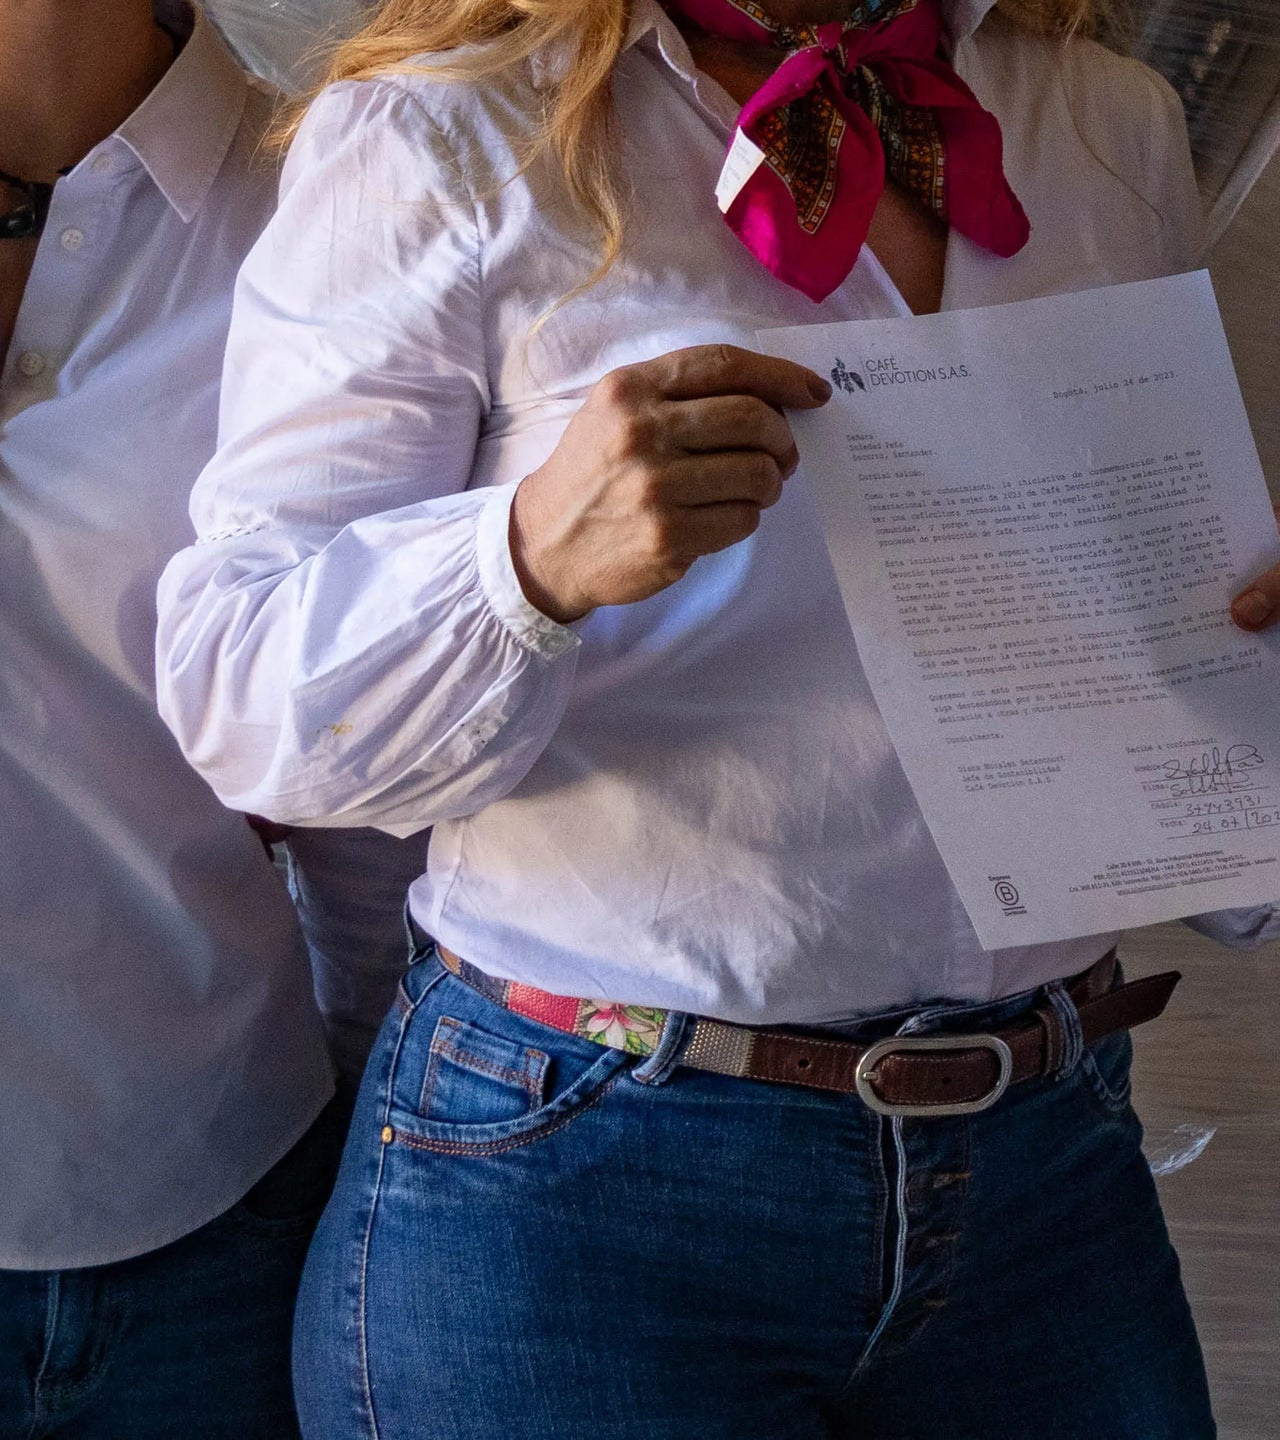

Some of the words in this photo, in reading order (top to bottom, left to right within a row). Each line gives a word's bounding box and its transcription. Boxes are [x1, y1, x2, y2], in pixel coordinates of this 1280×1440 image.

[865, 354, 899, 372] CAFÉ
[870, 368, 937, 386] DEVOTION
[938, 364, 972, 380] S.A.S.
[1092, 381, 1119, 393] julio
[999, 886, 1015, 901] B
